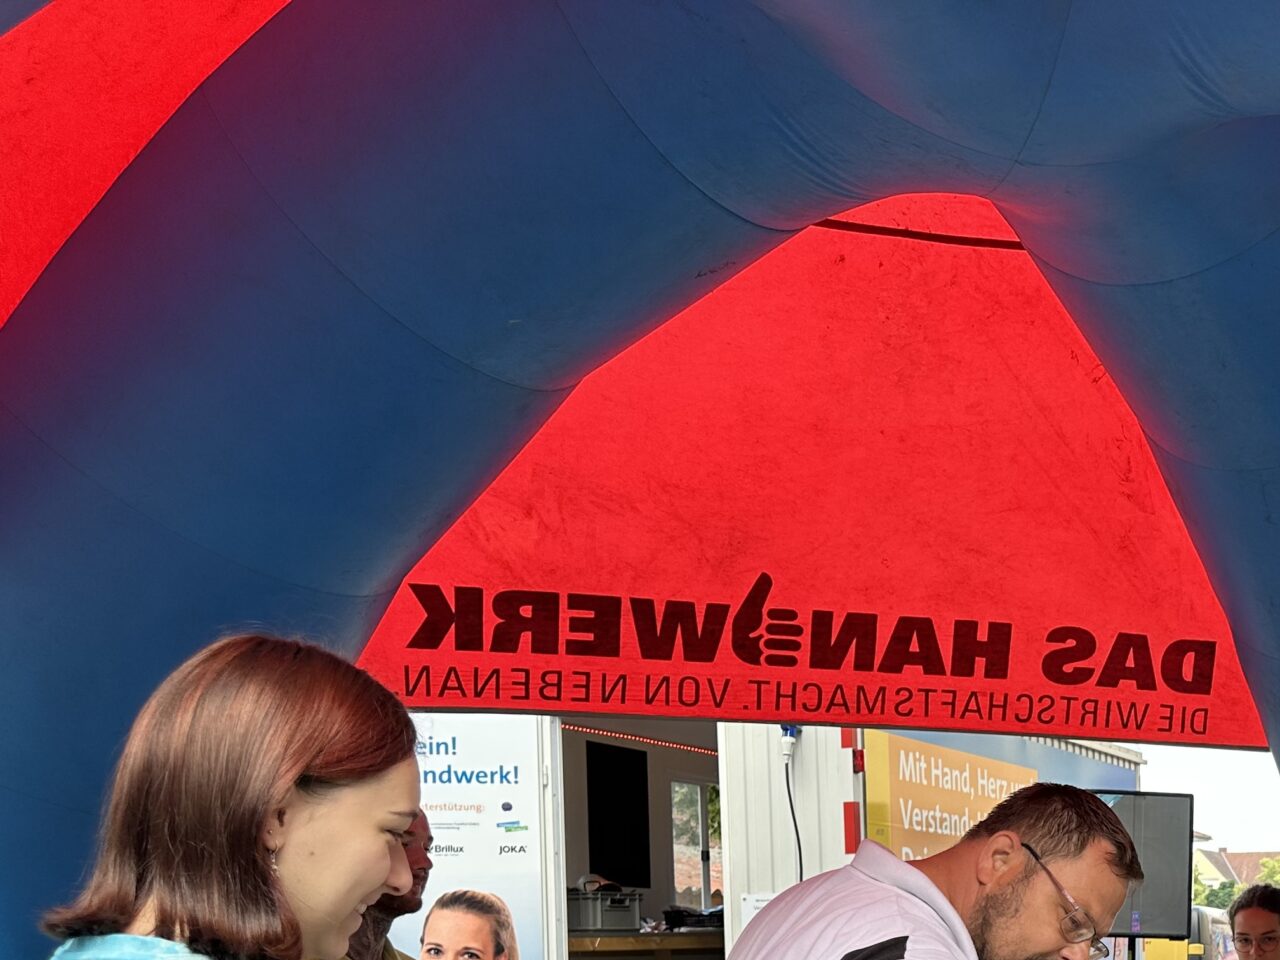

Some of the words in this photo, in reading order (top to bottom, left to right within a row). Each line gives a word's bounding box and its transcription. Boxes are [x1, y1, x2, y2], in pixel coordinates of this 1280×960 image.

[423, 764, 519, 785] ndwerk!
[899, 749, 928, 785] Mit
[930, 757, 975, 799] Hand,
[977, 767, 1009, 799] Herz
[421, 803, 486, 814] terstützung:
[435, 845, 464, 853] Brillux
[499, 845, 526, 855] JOKA
